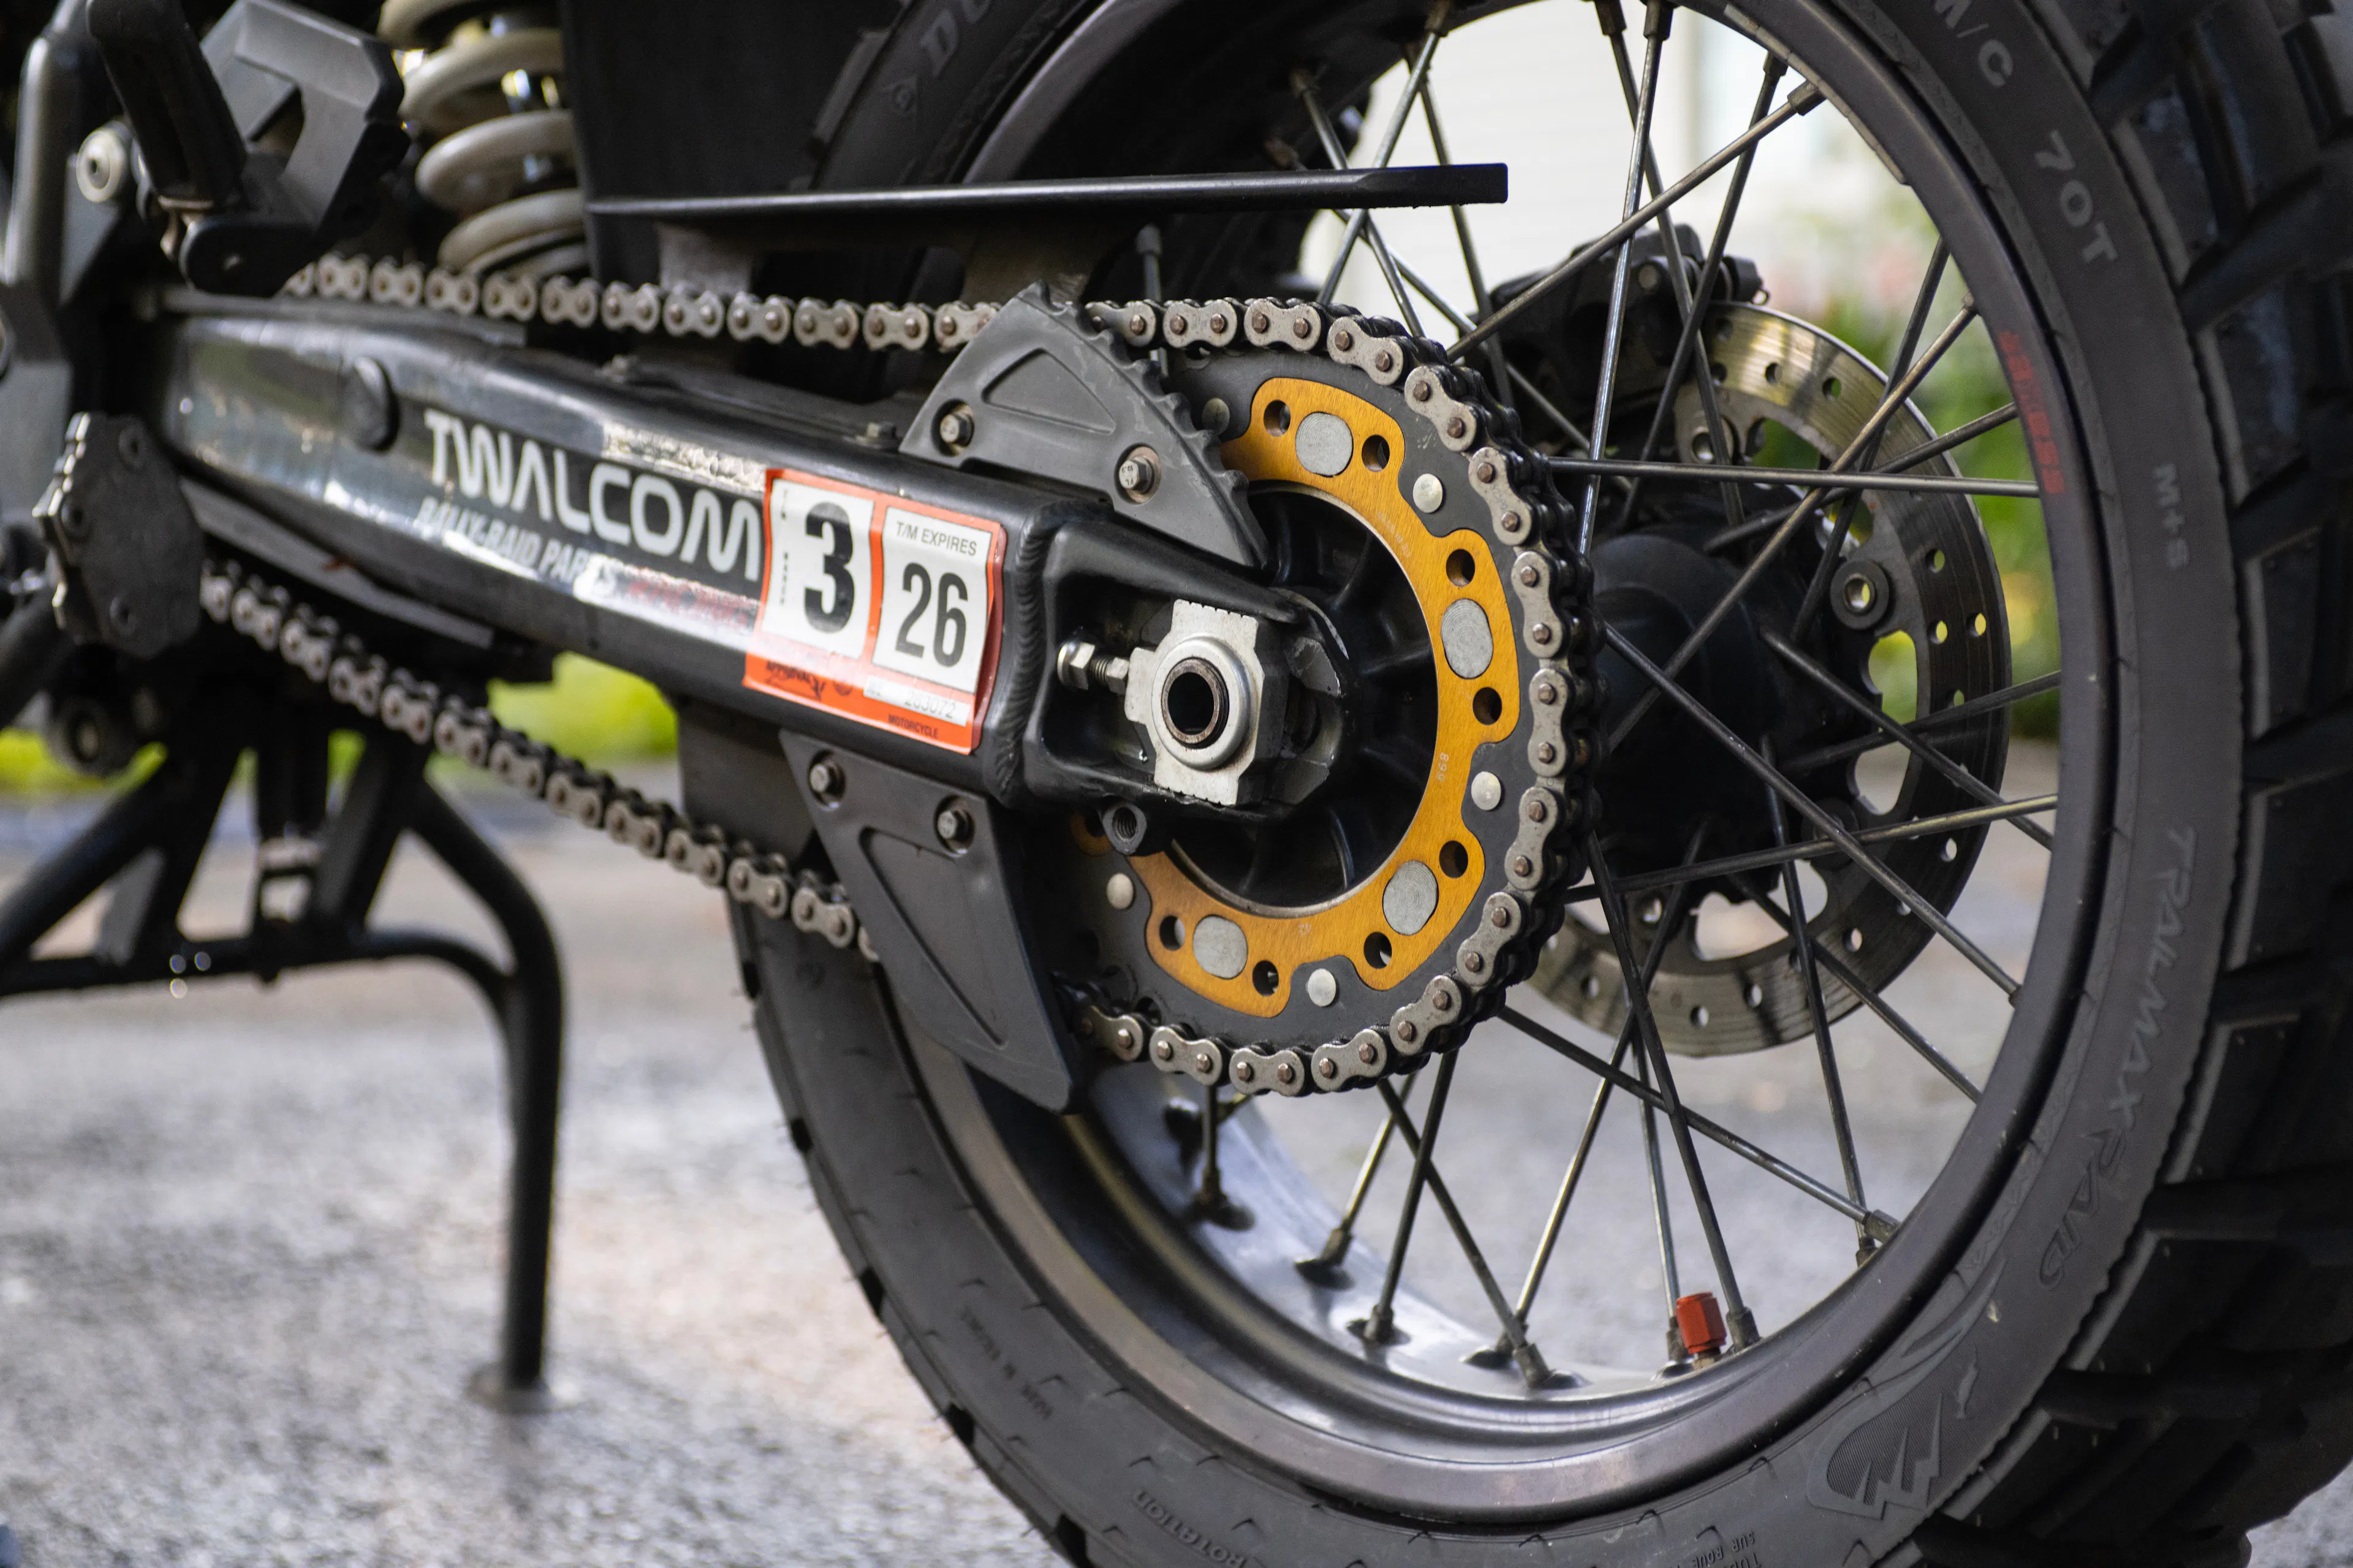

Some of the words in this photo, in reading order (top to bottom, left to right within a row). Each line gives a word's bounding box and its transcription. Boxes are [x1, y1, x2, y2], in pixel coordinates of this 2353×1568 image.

[2034, 129, 2120, 264] 70T
[424, 409, 763, 582] TWALCOM
[896, 521, 919, 540] T/M
[921, 528, 977, 557] EXPIRES
[804, 501, 855, 634] 3
[895, 562, 969, 668] 26
[888, 713, 939, 740] MOTORCYCLE
